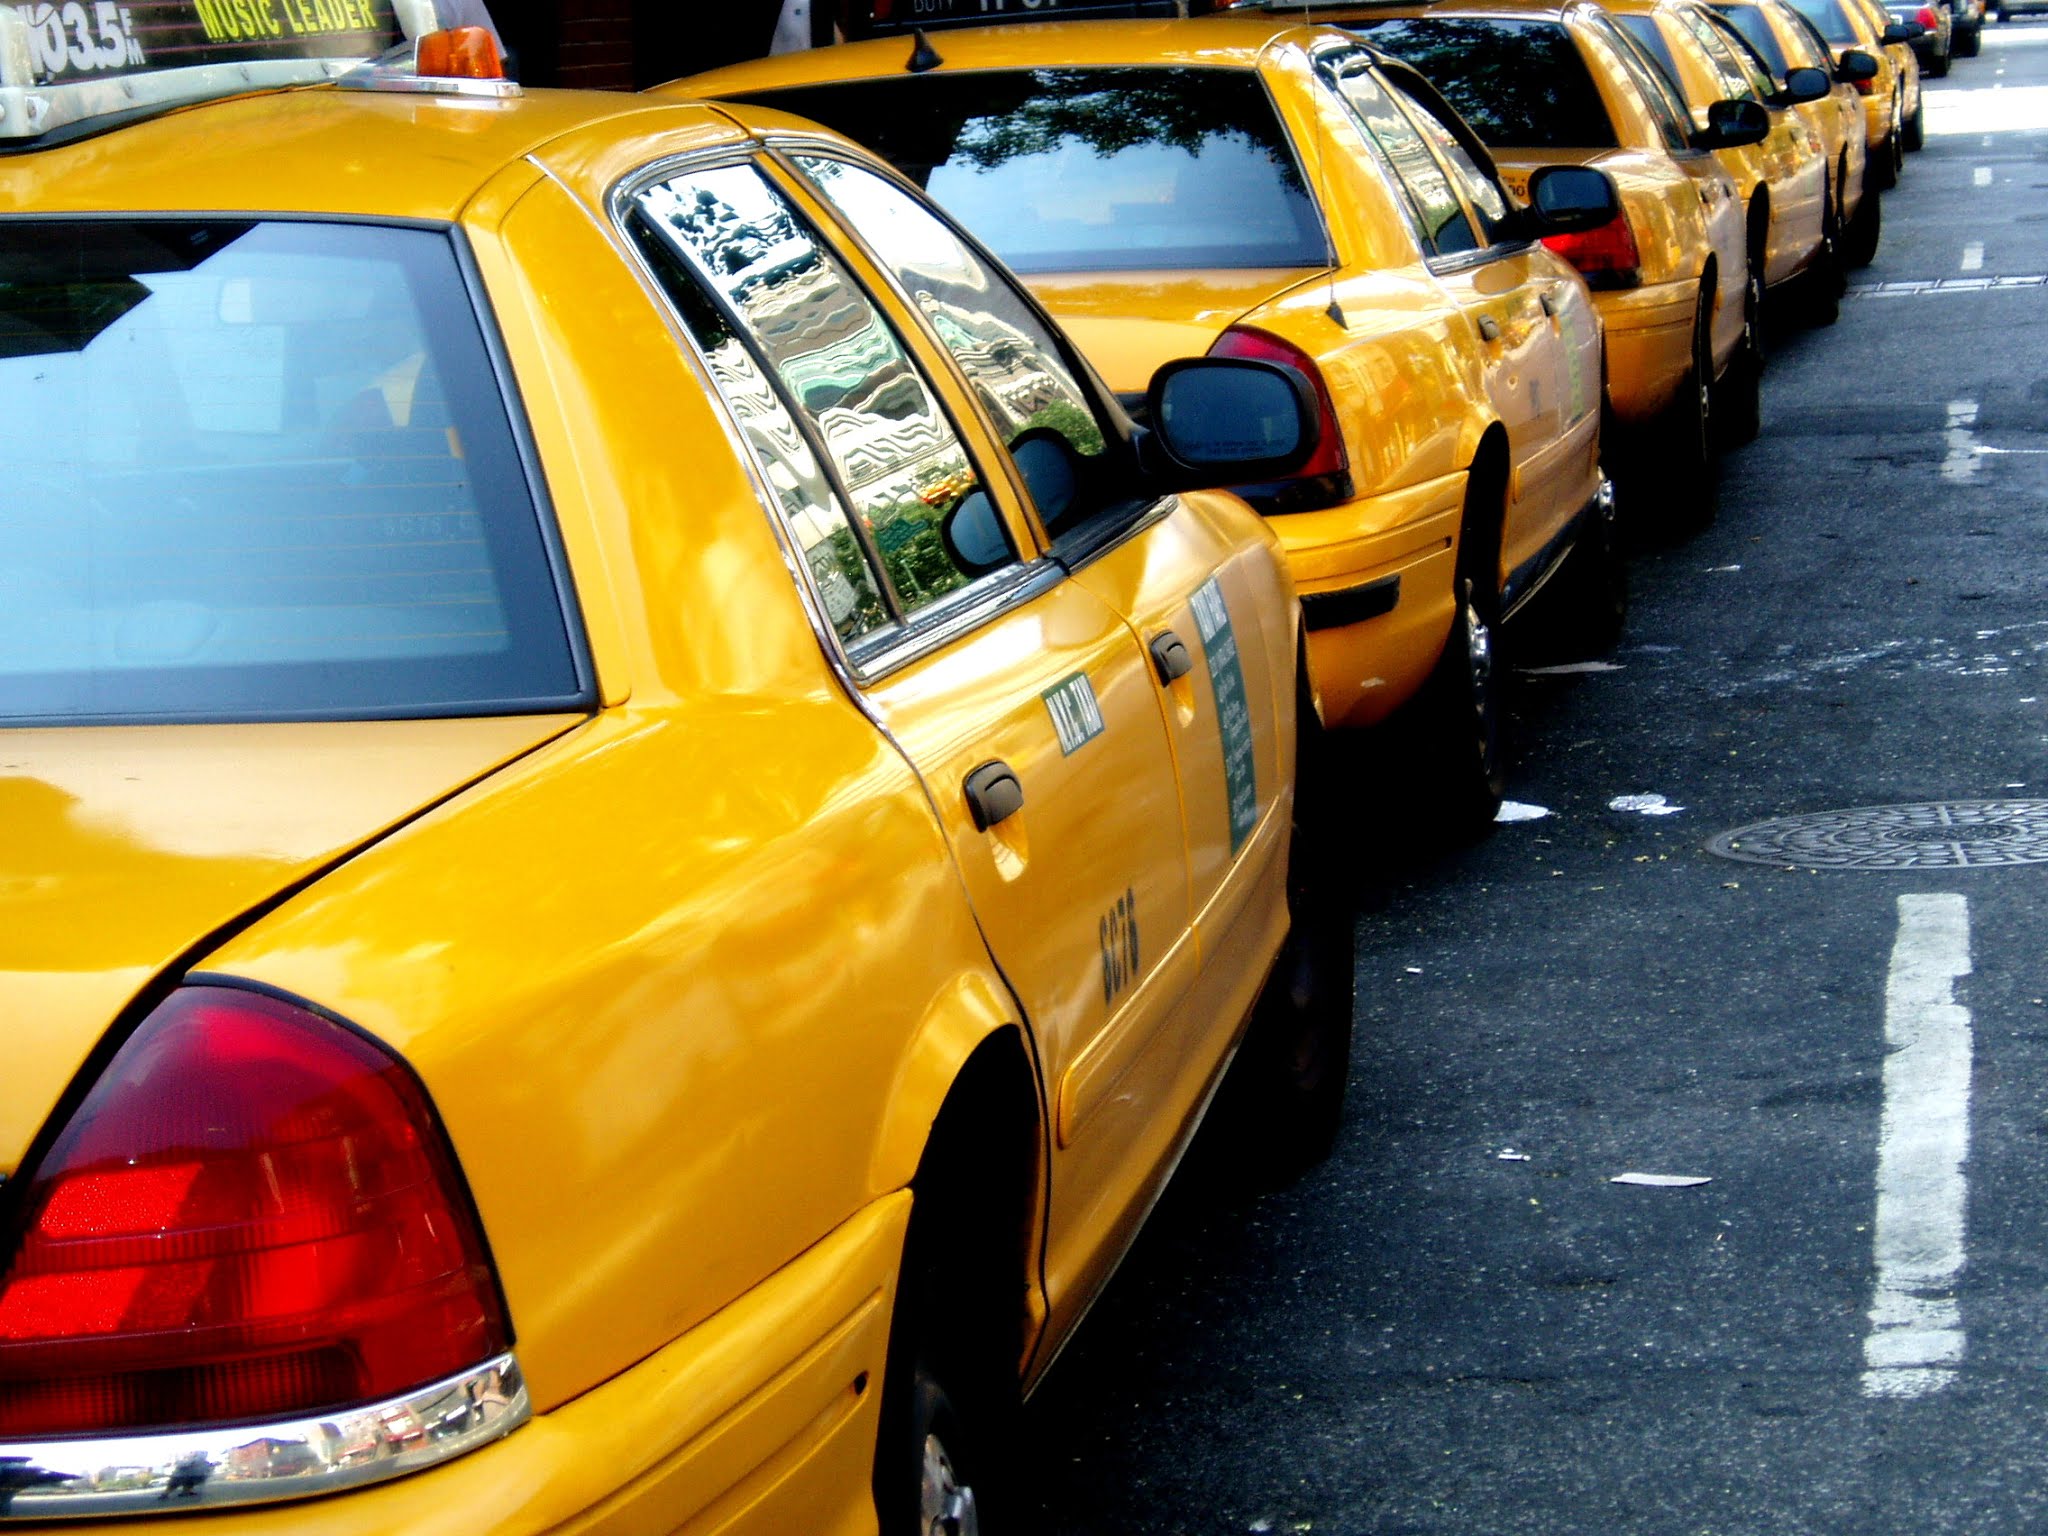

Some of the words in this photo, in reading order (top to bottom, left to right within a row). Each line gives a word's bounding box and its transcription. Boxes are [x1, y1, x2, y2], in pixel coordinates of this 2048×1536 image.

[16, 1, 127, 74] 103.5
[193, 0, 281, 39] MUSIC
[282, 0, 377, 33] LEADER
